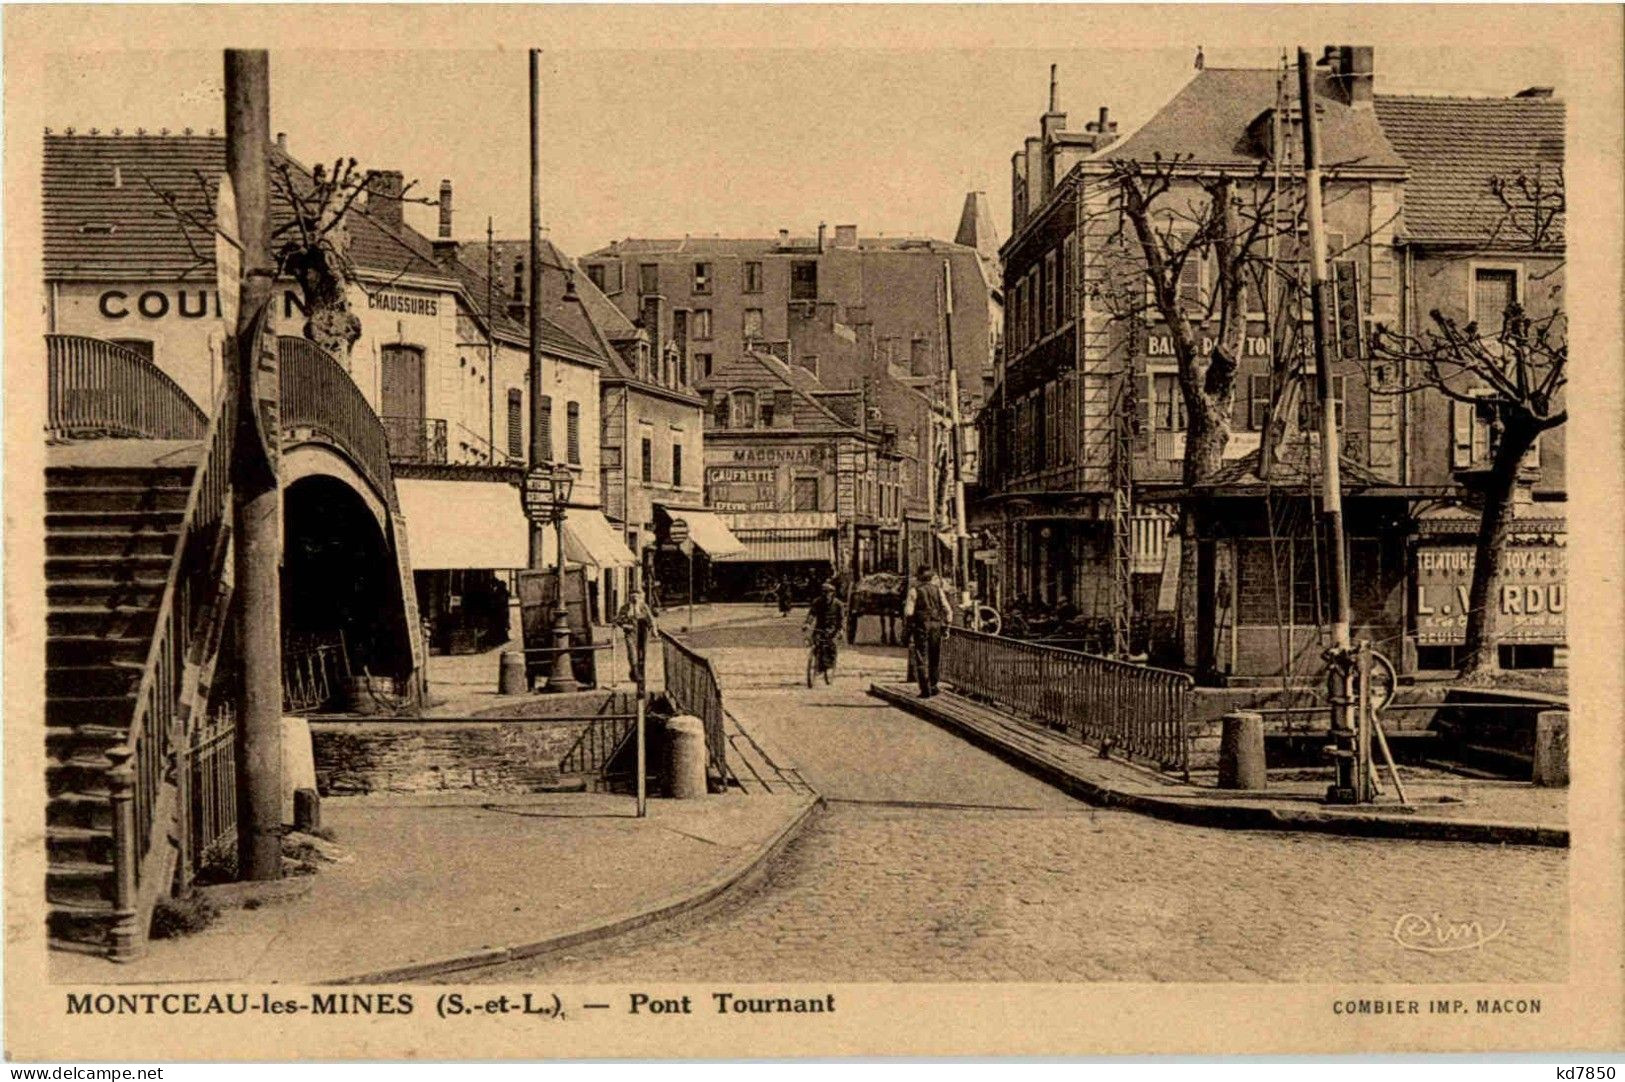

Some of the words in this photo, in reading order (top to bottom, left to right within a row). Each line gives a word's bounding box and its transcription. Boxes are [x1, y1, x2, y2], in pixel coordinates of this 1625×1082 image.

[368, 292, 438, 317] CHAUSSURES
[711, 470, 775, 482] GAUFRETTE
[1505, 551, 1550, 569] TOYAGE
[1456, 585, 1565, 615] VRDU
